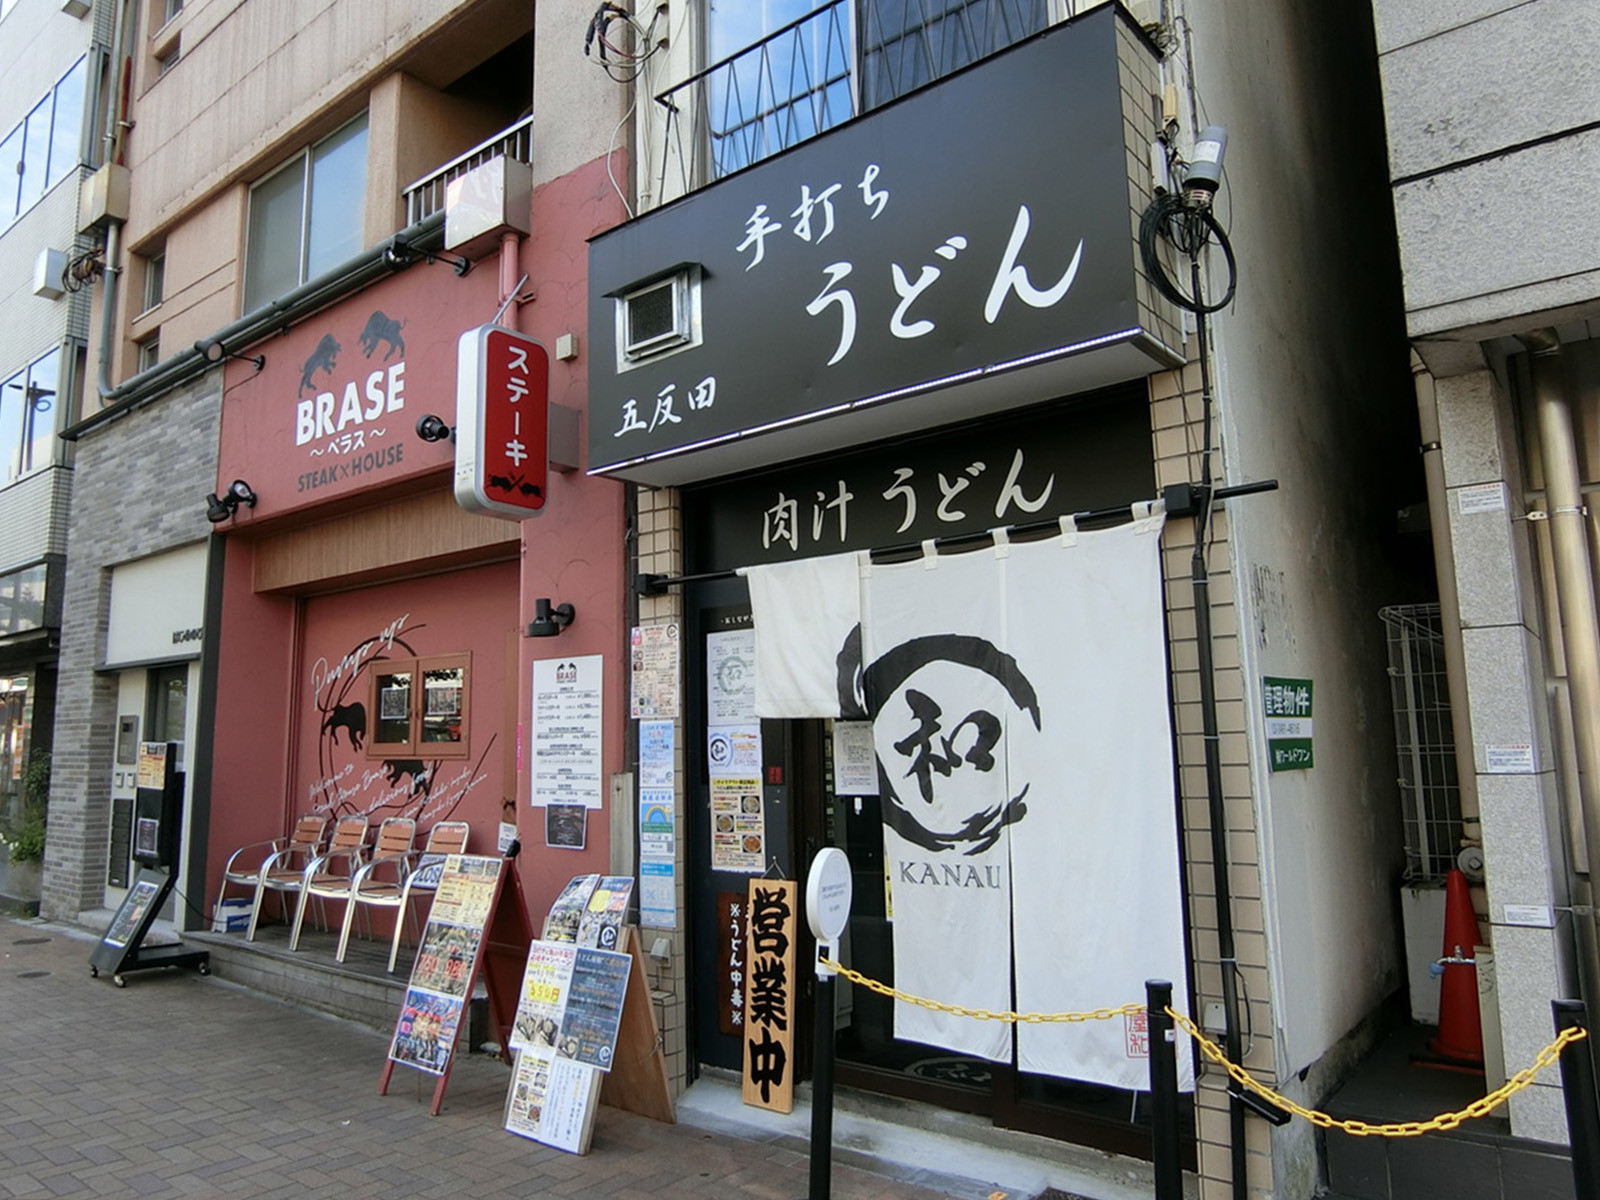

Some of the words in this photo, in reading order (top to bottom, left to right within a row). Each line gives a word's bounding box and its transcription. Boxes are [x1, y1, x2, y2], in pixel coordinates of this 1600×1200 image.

[735, 164, 890, 271] 手打ち
[806, 204, 1083, 366] うどん
[296, 362, 405, 447] BRASE
[505, 345, 529, 467] ステーキ
[614, 376, 716, 437] 五反田
[894, 688, 1002, 803] 和
[899, 861, 1001, 888] KANAU
[749, 887, 791, 1103] 営業中
